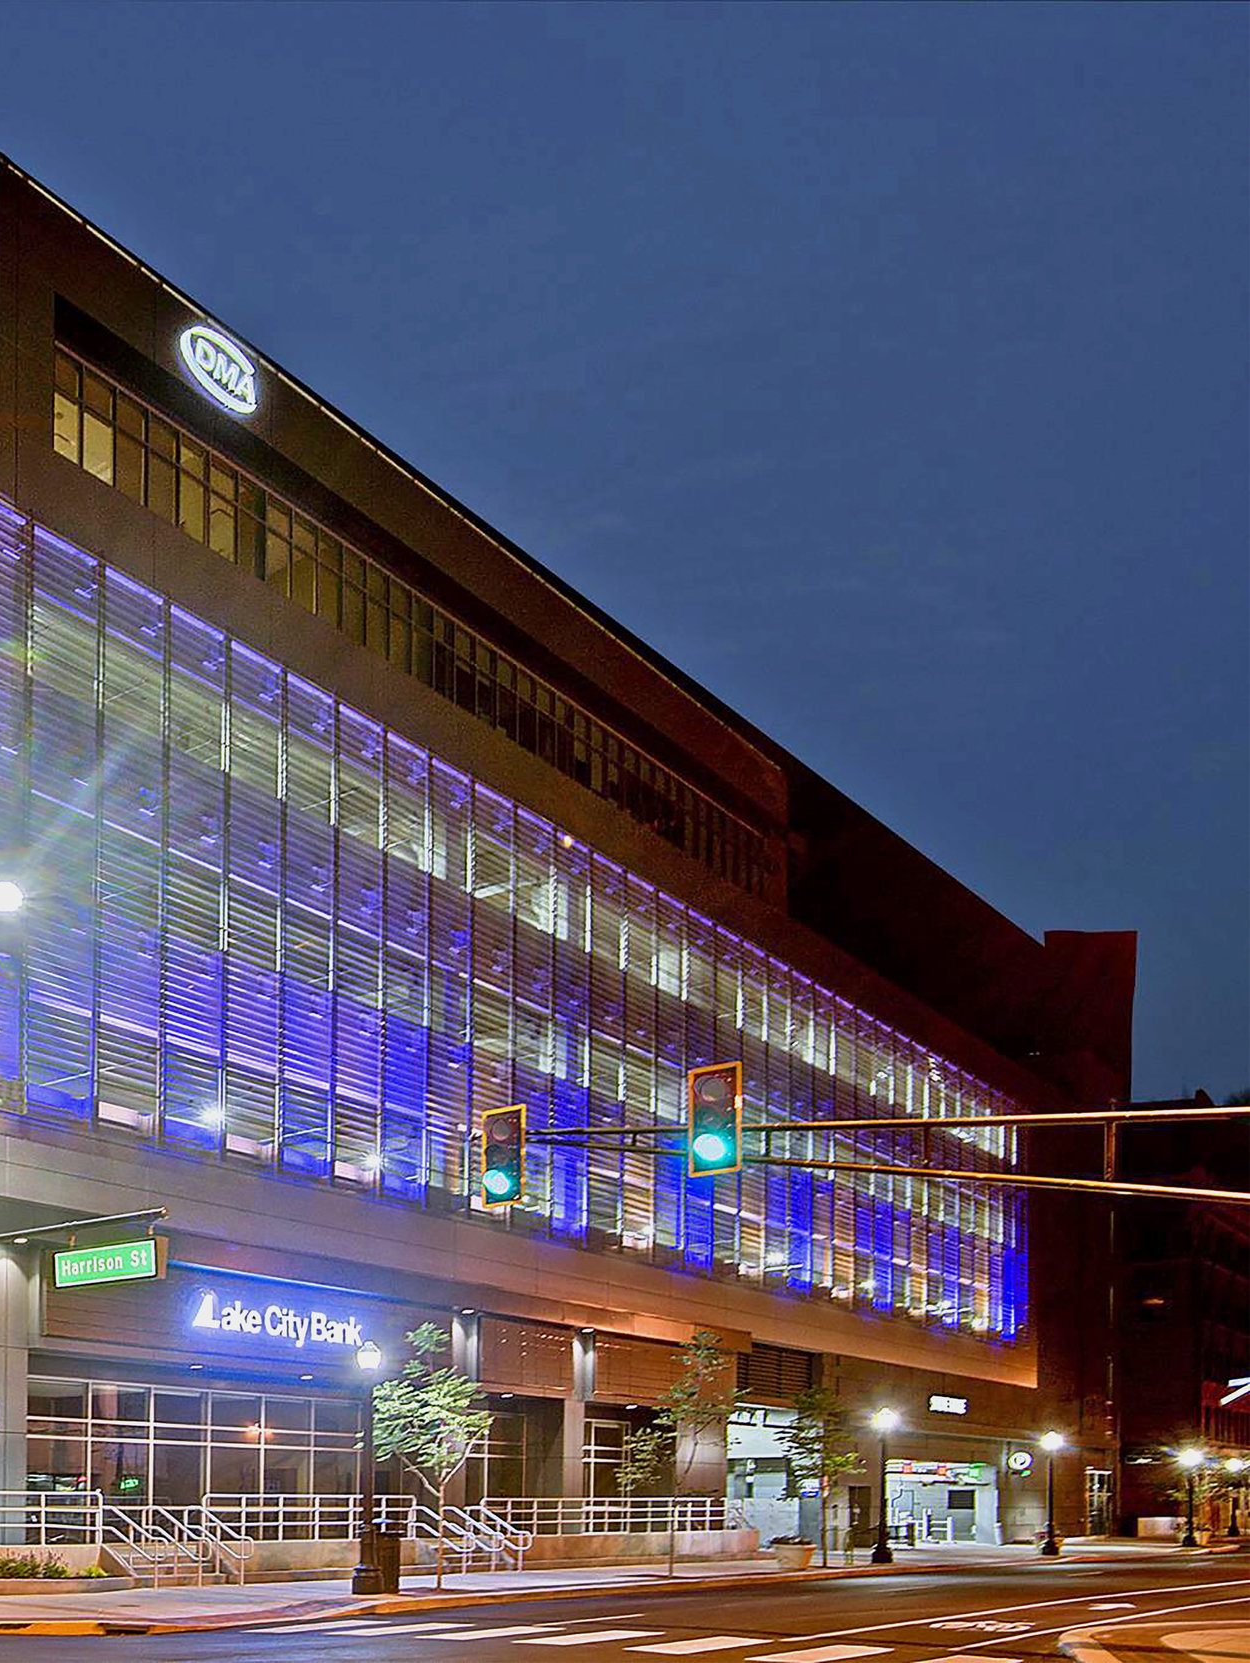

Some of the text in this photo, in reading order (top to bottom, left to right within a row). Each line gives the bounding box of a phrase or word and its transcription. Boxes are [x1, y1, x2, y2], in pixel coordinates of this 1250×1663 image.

[196, 338, 256, 405] DMA
[61, 1249, 147, 1276] Harrison St
[193, 1295, 363, 1347] Lake City Bank
